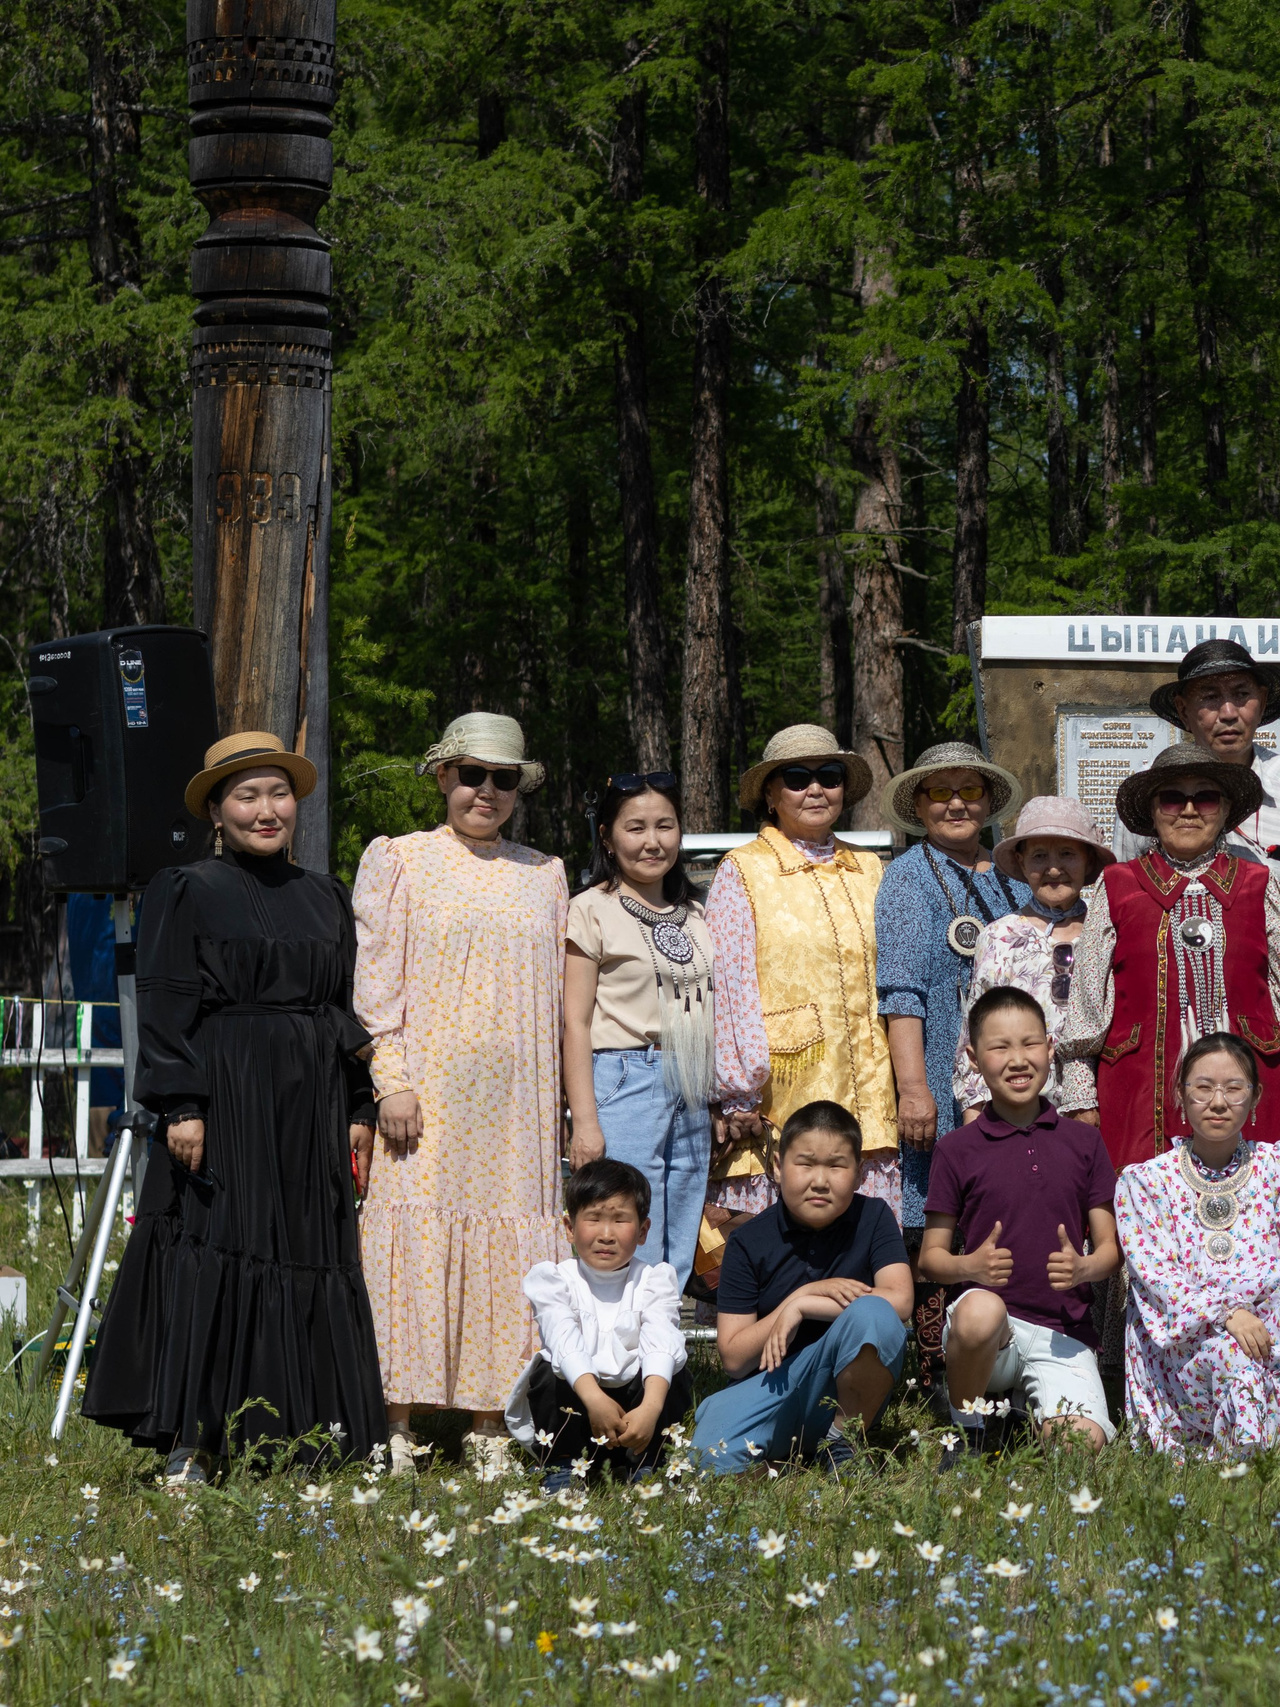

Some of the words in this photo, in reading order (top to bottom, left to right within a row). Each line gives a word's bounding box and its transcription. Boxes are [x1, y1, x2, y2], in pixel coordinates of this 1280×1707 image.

[1089, 741, 1148, 749] ВЕТЕРАННАРА
[1077, 760, 1130, 769] ЦЫПАНДИН
[173, 831, 185, 842] RCF
